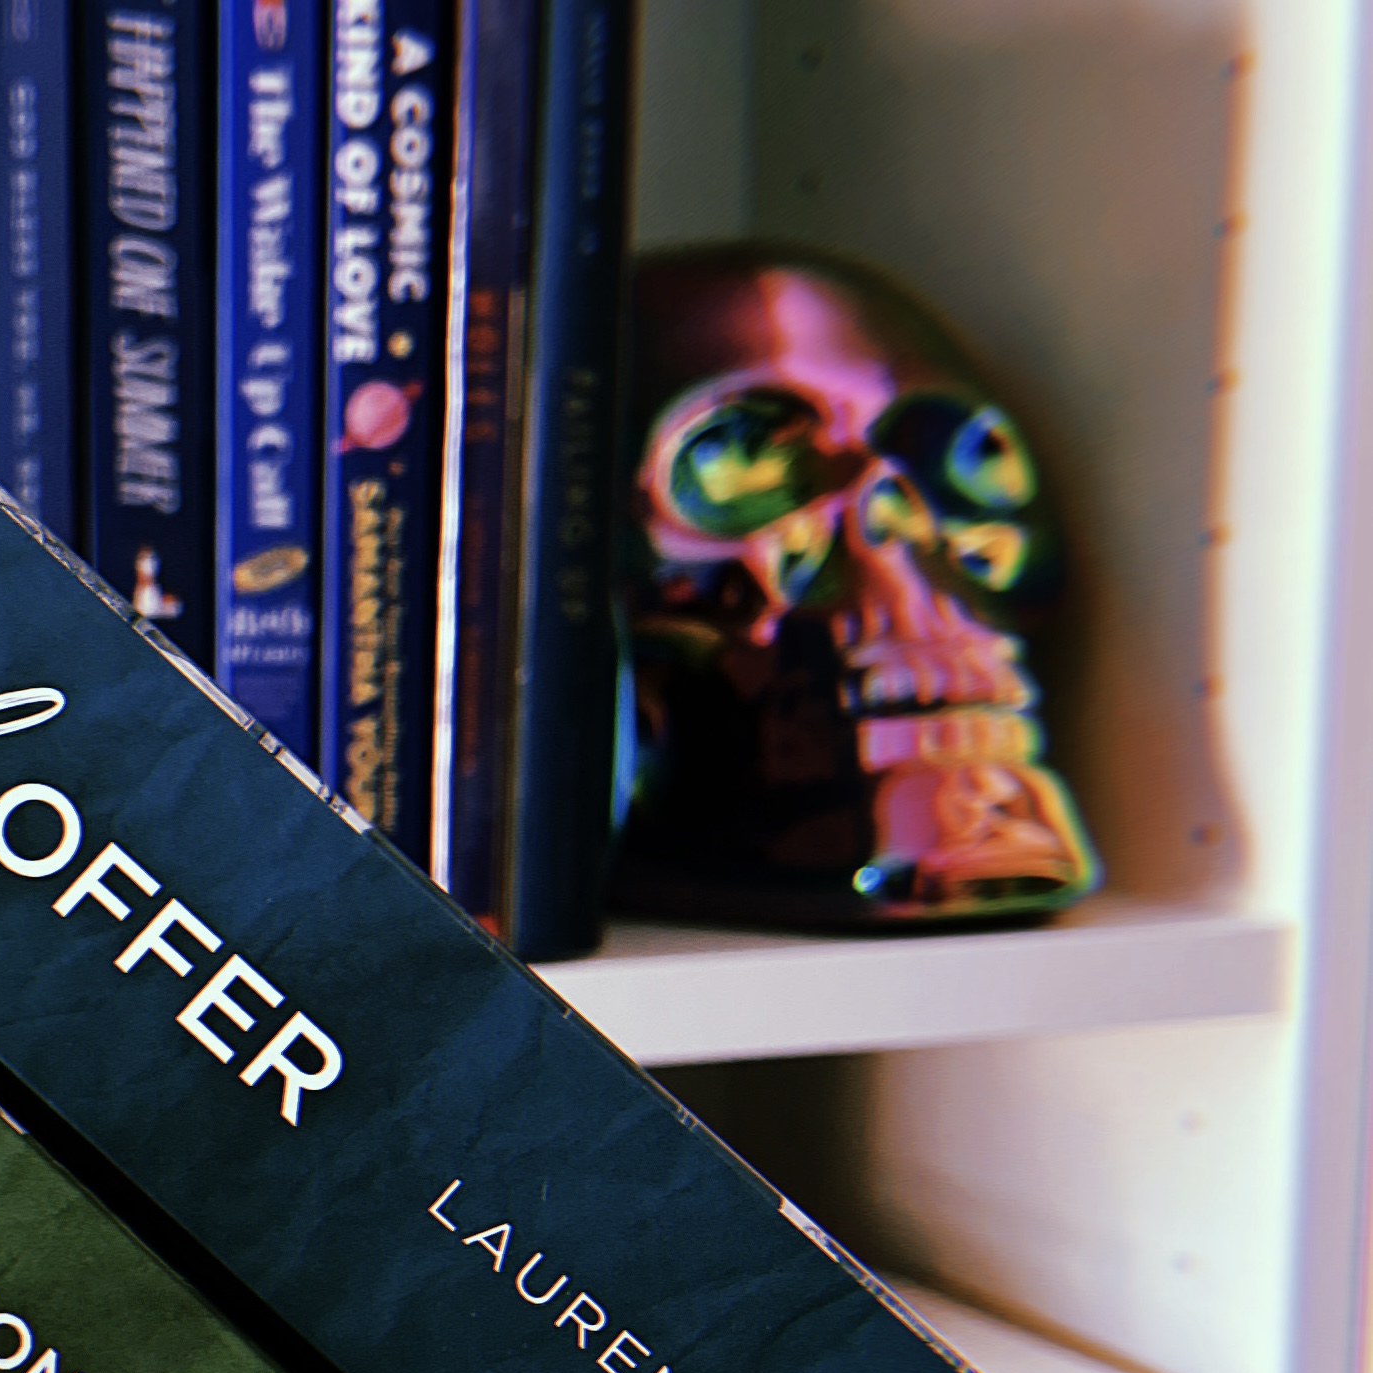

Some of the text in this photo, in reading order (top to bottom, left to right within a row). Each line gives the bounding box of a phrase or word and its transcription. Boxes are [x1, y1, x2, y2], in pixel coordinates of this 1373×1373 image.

[334, 139, 380, 214] OF
[387, 85, 433, 303] COSMIC
[333, 226, 380, 366] LOVE
